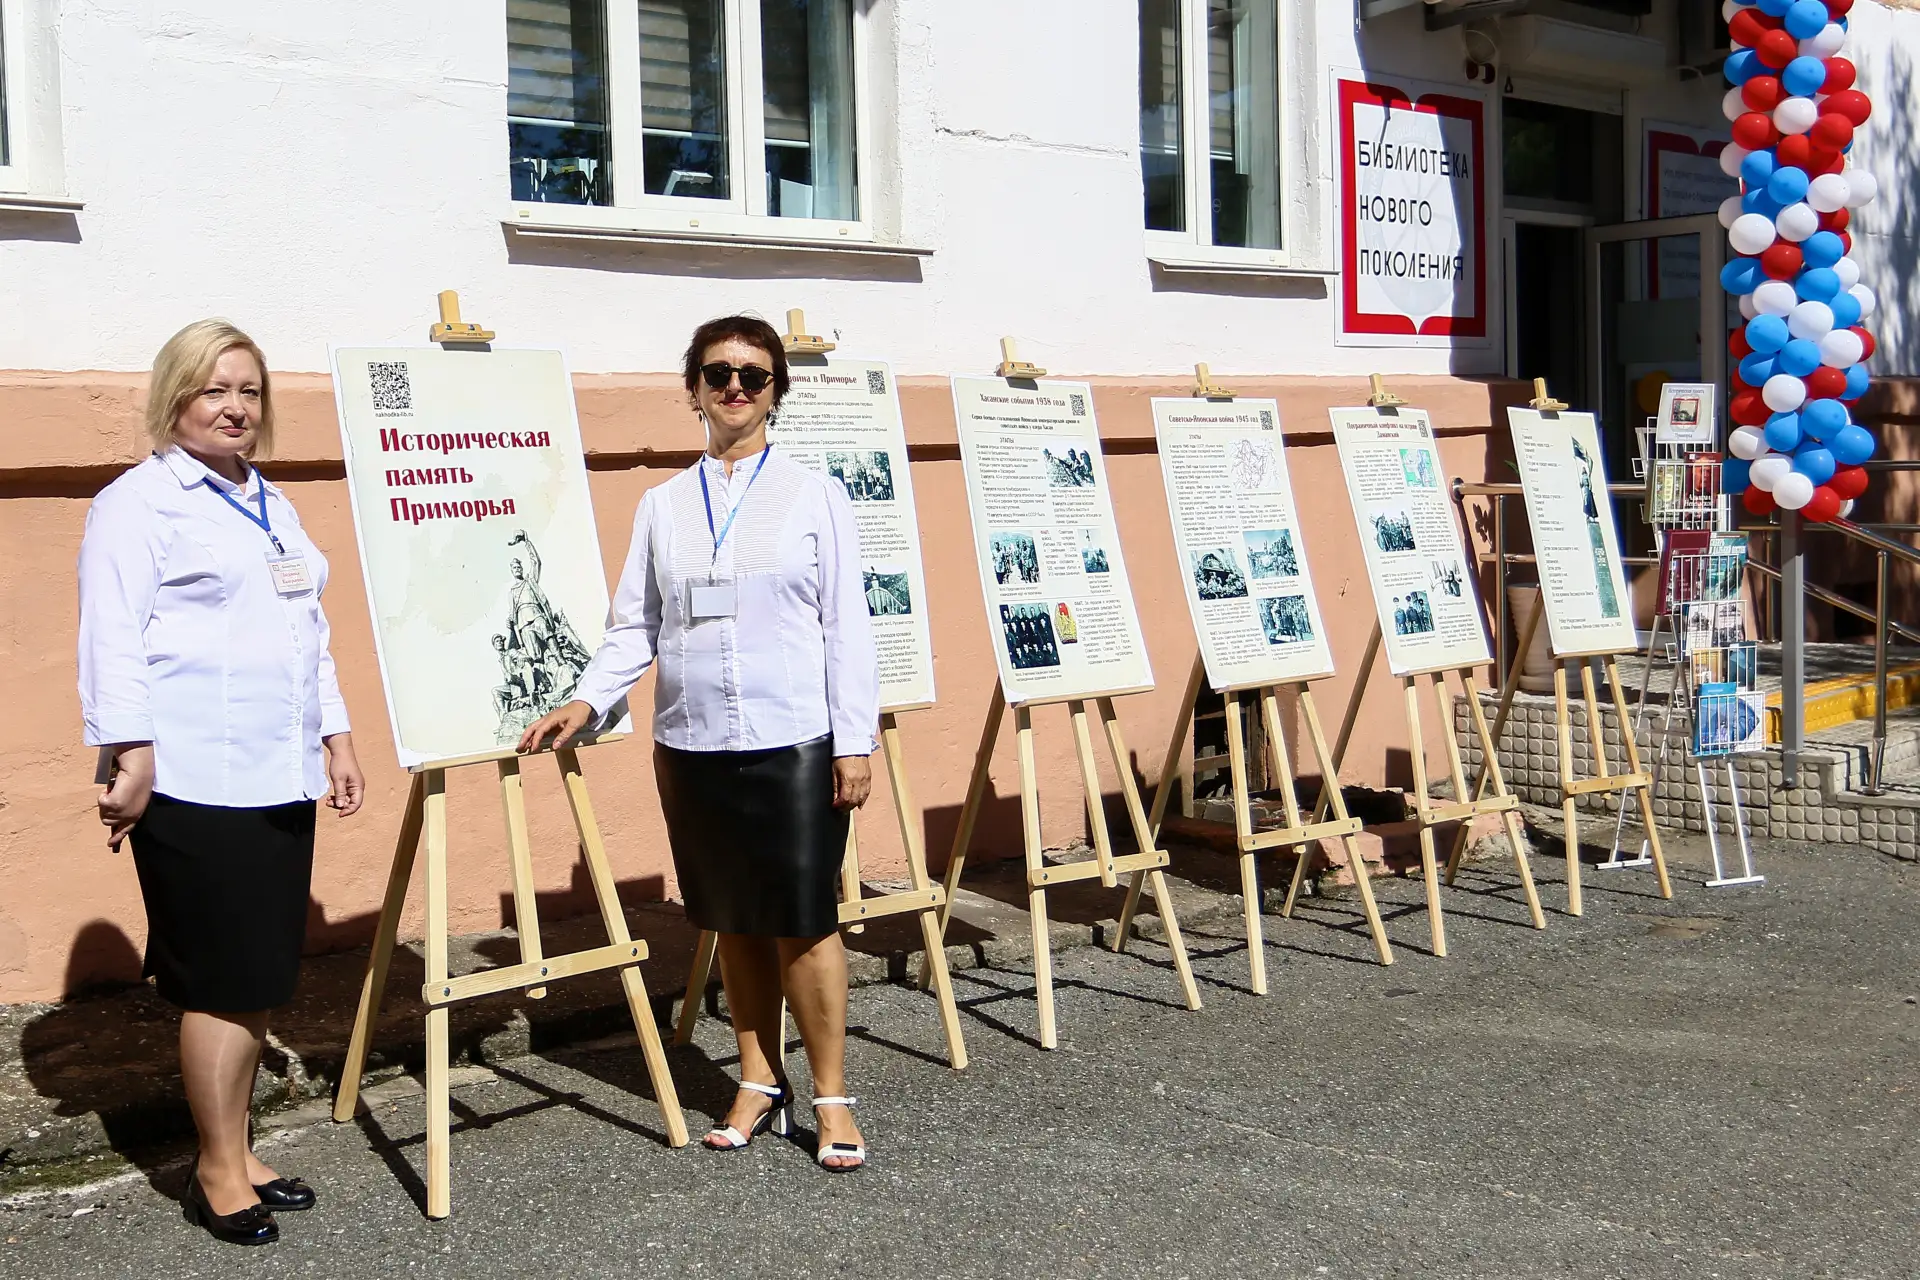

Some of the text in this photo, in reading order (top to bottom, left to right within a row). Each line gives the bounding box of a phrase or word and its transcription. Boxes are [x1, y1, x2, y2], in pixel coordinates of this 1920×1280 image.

[1358, 140, 1469, 179] БИБЛИОТЕКА
[1359, 194, 1432, 226] НОВОГО
[1360, 249, 1464, 280] ПОКОЛЕНИЯ
[820, 373, 857, 386] Приморье
[979, 393, 1066, 407] Хасанские события 1938 года
[1168, 414, 1218, 423] Советско-Японская
[1218, 415, 1235, 423] война
[1235, 415, 1249, 423] 1945
[379, 428, 551, 455] Историческая
[385, 466, 474, 487] память
[390, 497, 516, 525] Приморья
